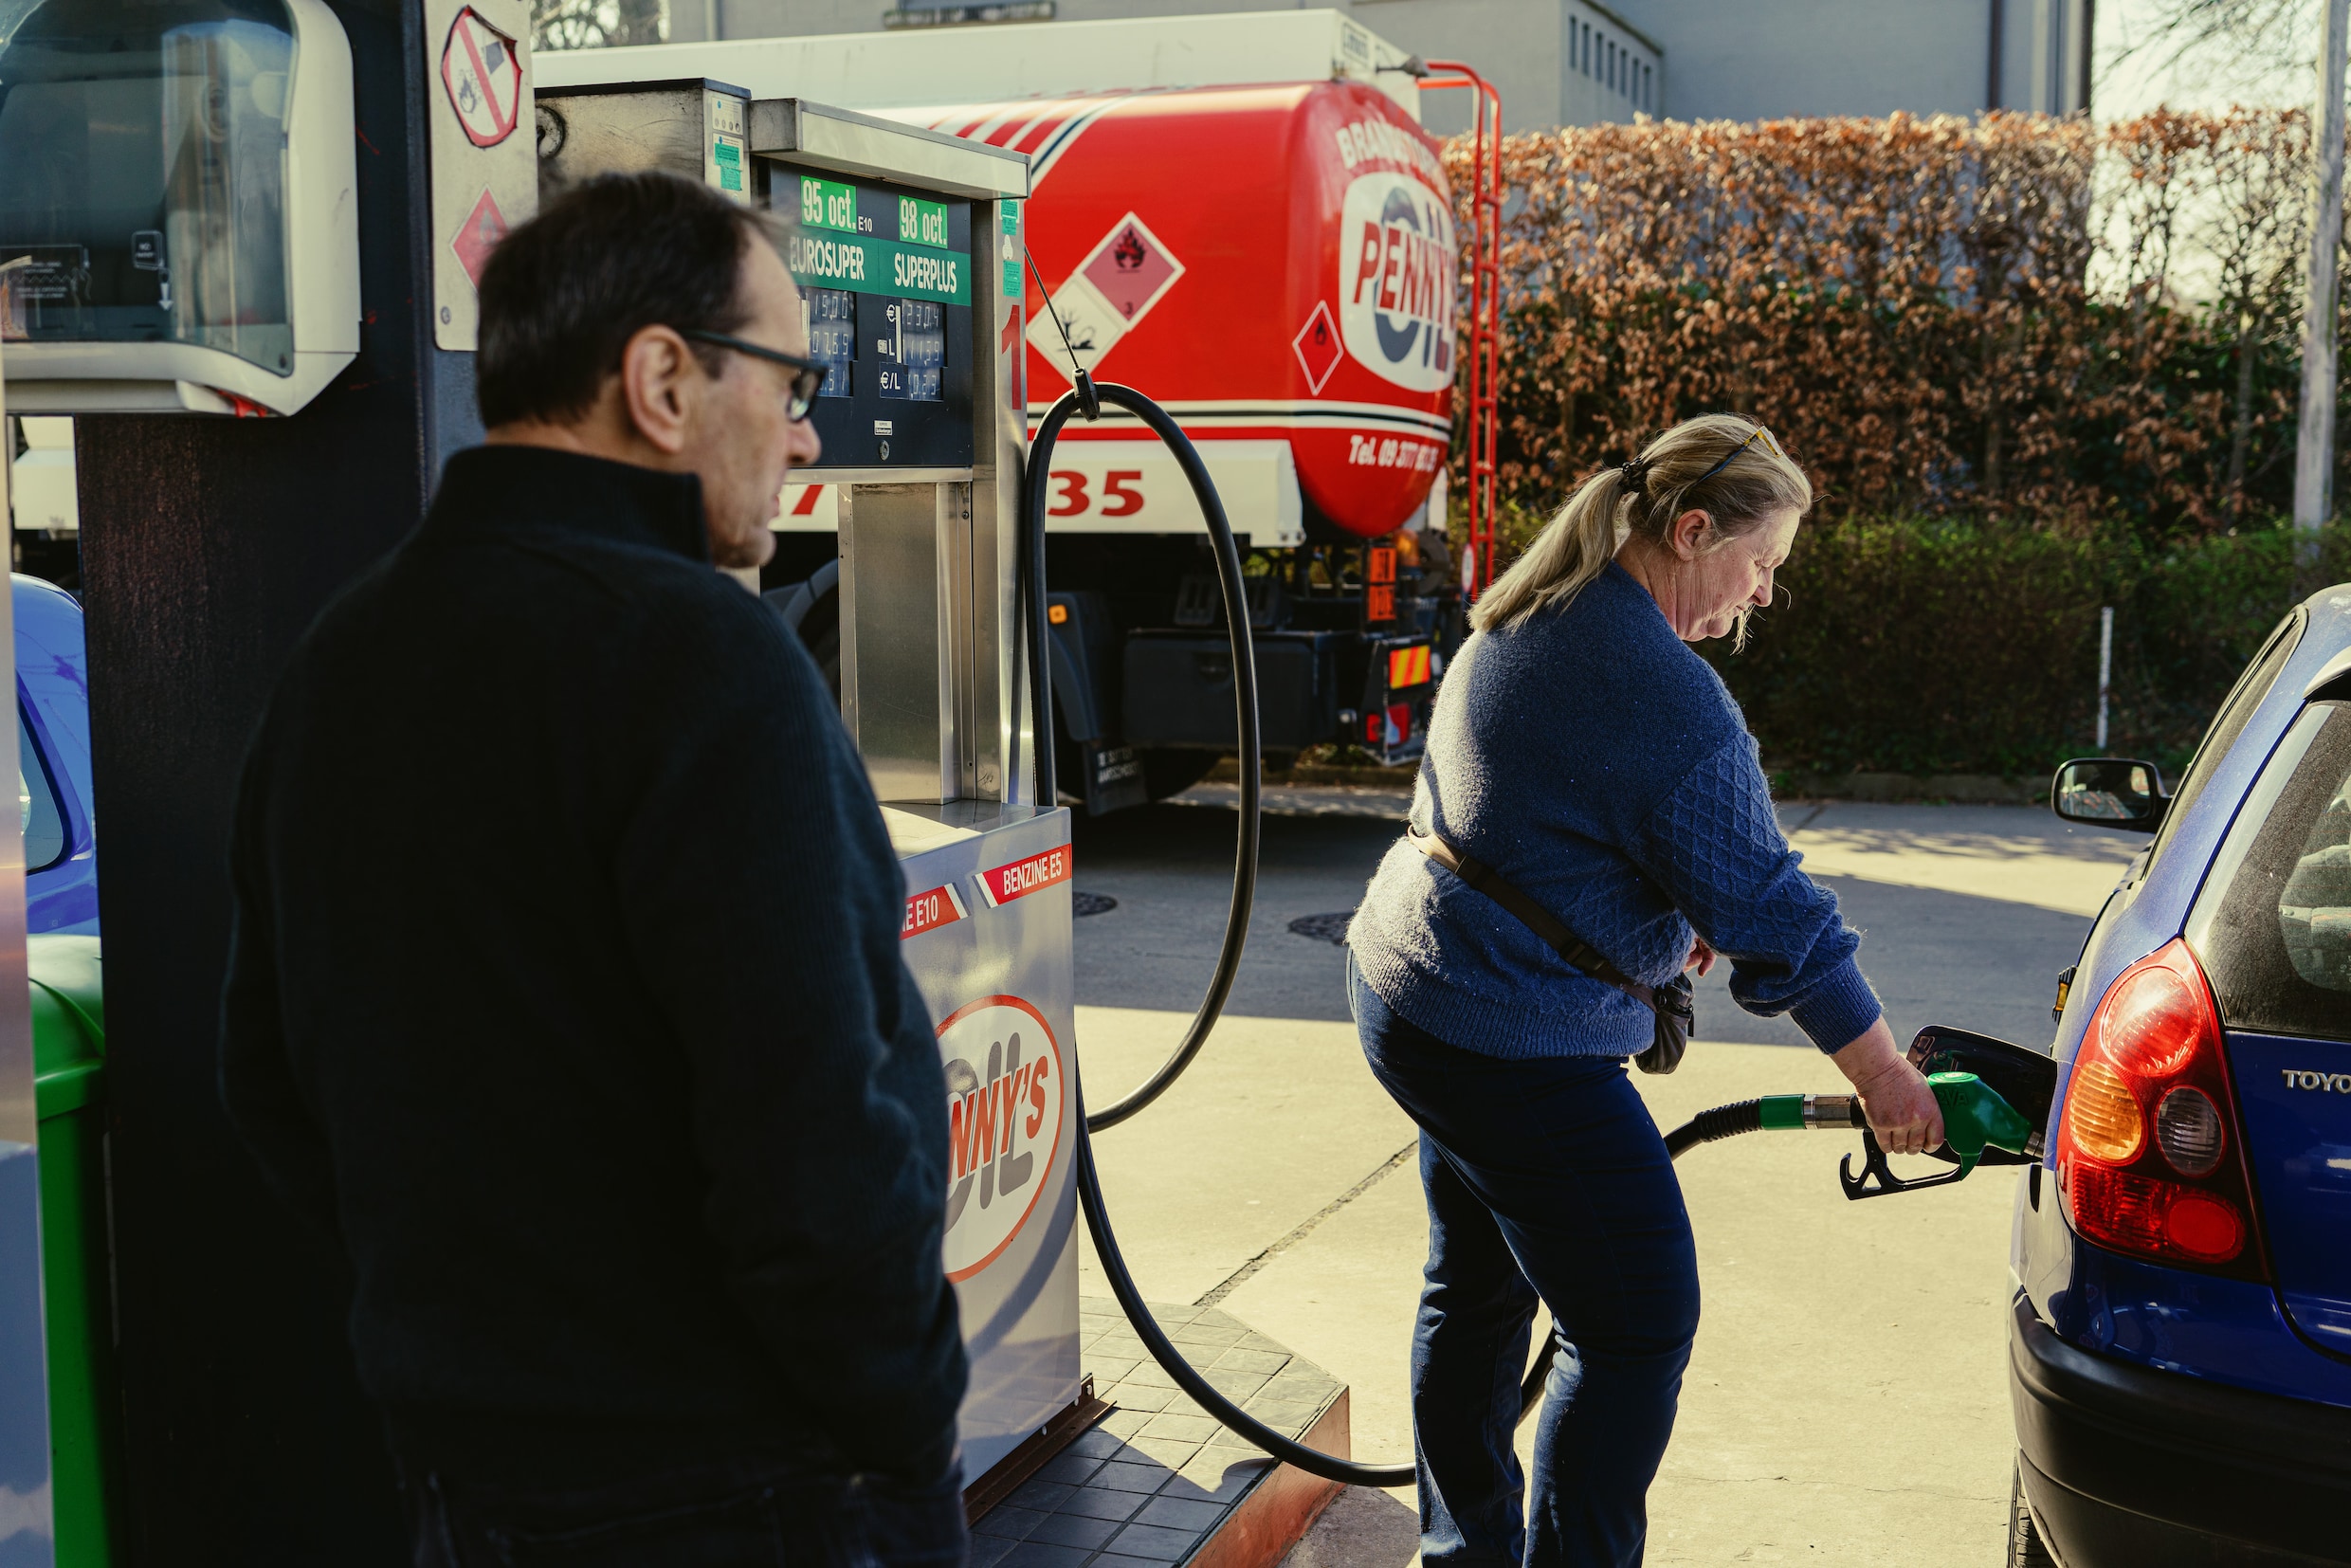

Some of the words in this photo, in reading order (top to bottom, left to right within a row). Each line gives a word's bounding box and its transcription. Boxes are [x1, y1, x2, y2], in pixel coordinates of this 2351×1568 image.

[803, 179, 822, 225] 95
[828, 188, 856, 229] oct.
[858, 216, 873, 232] E10
[901, 198, 918, 240] 98
[921, 209, 947, 246] oct.
[790, 236, 865, 281] EUROSUPER
[894, 252, 957, 294] SUPERPLUS
[1001, 304, 1022, 410] 1
[1003, 856, 1048, 896] BENZINE
[1049, 851, 1063, 879] E5
[916, 894, 939, 928] E10
[2282, 1068, 2351, 1093] TOYO
[948, 1055, 1048, 1185] NNY'S
